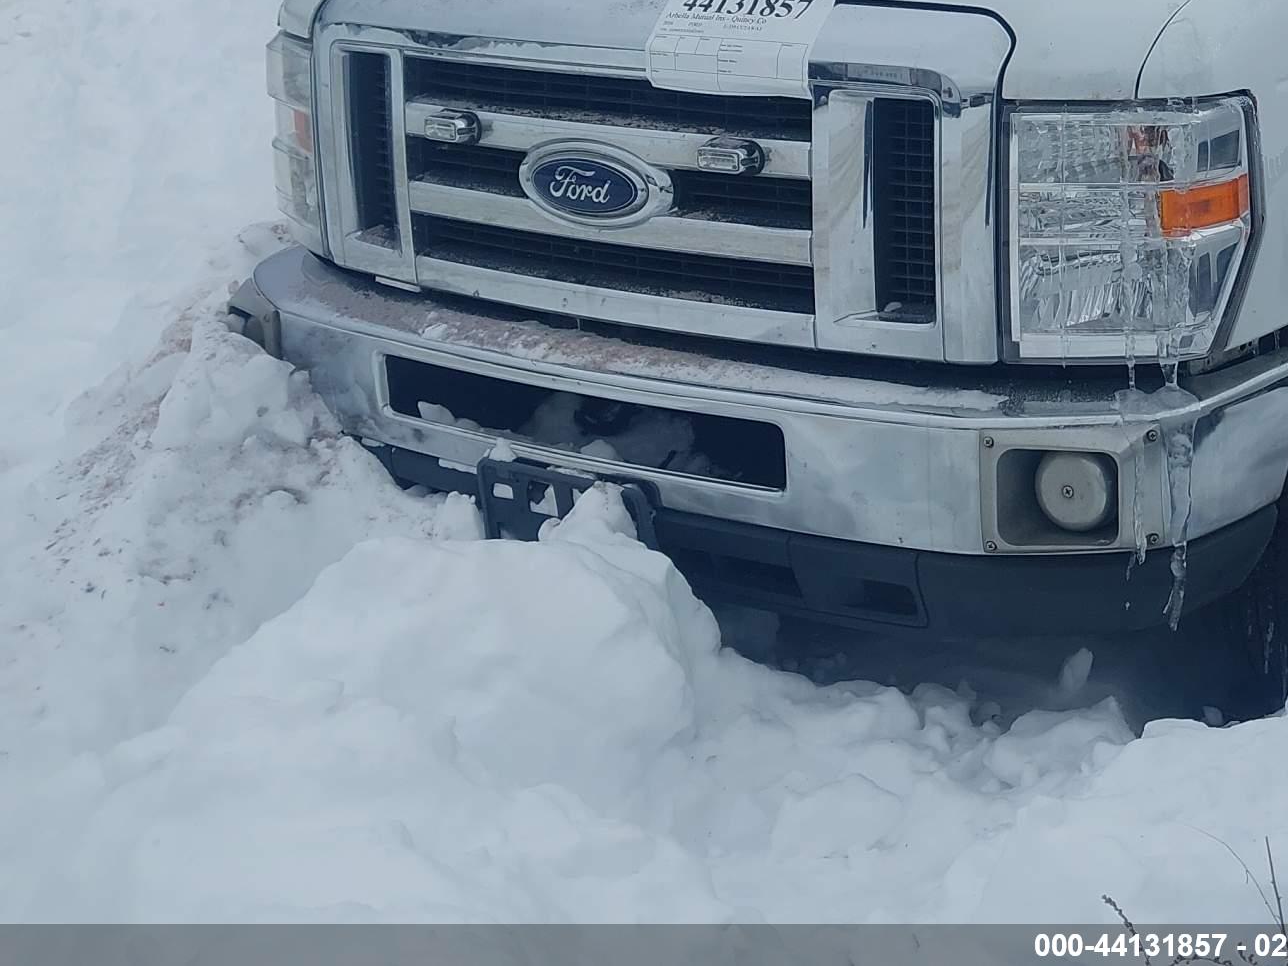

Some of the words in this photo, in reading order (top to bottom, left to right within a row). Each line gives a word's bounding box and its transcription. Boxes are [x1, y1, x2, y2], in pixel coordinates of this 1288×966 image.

[690, 13, 715, 21] Mutual
[731, 15, 756, 25] Quincy
[550, 165, 611, 204] Ford
